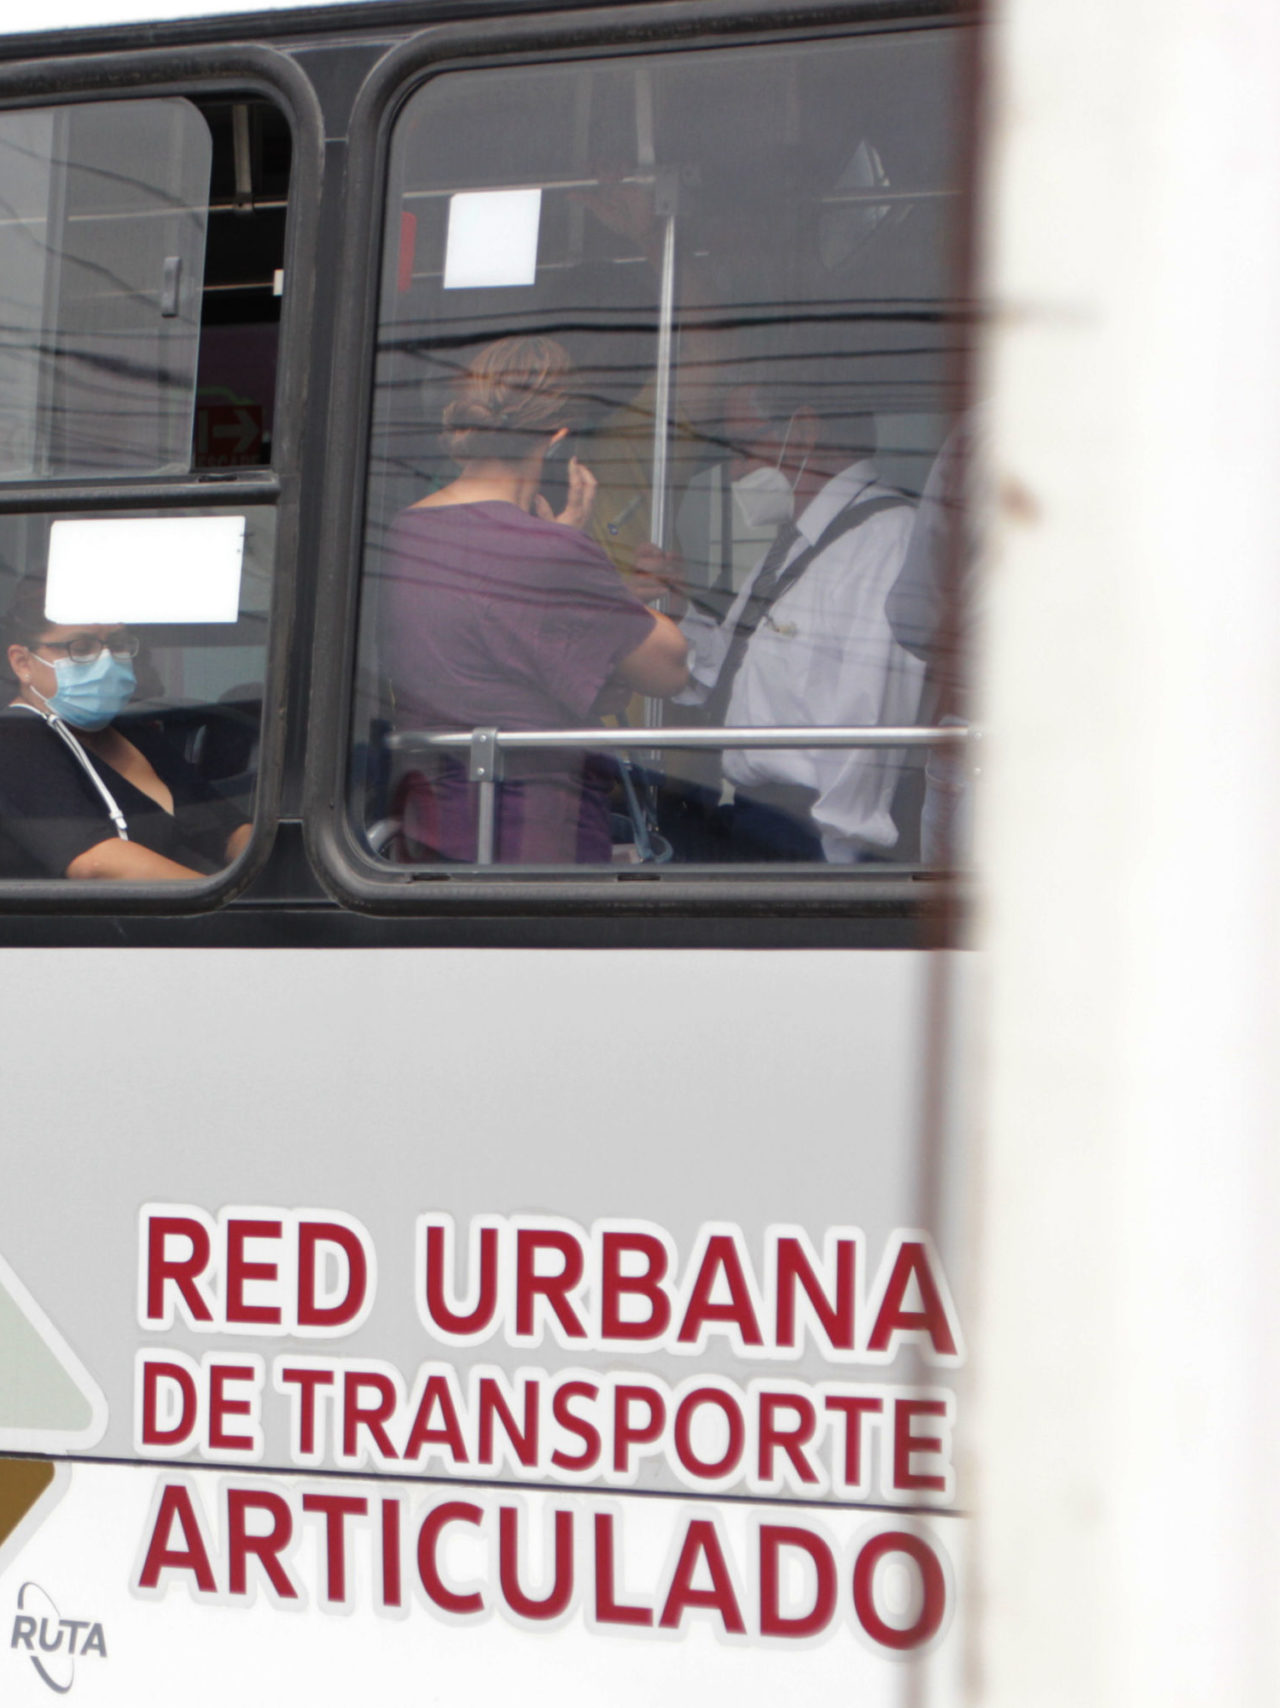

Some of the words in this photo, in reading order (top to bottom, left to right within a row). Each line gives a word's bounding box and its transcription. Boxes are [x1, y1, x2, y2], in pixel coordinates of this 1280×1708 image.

[148, 1217, 367, 1327] RED
[426, 1226, 958, 1355] URBANA
[141, 1362, 254, 1451] DE
[283, 1369, 947, 1490] TRANSPORTE
[138, 1484, 946, 1650] ARTICULADO
[11, 1615, 107, 1658] RUTA
